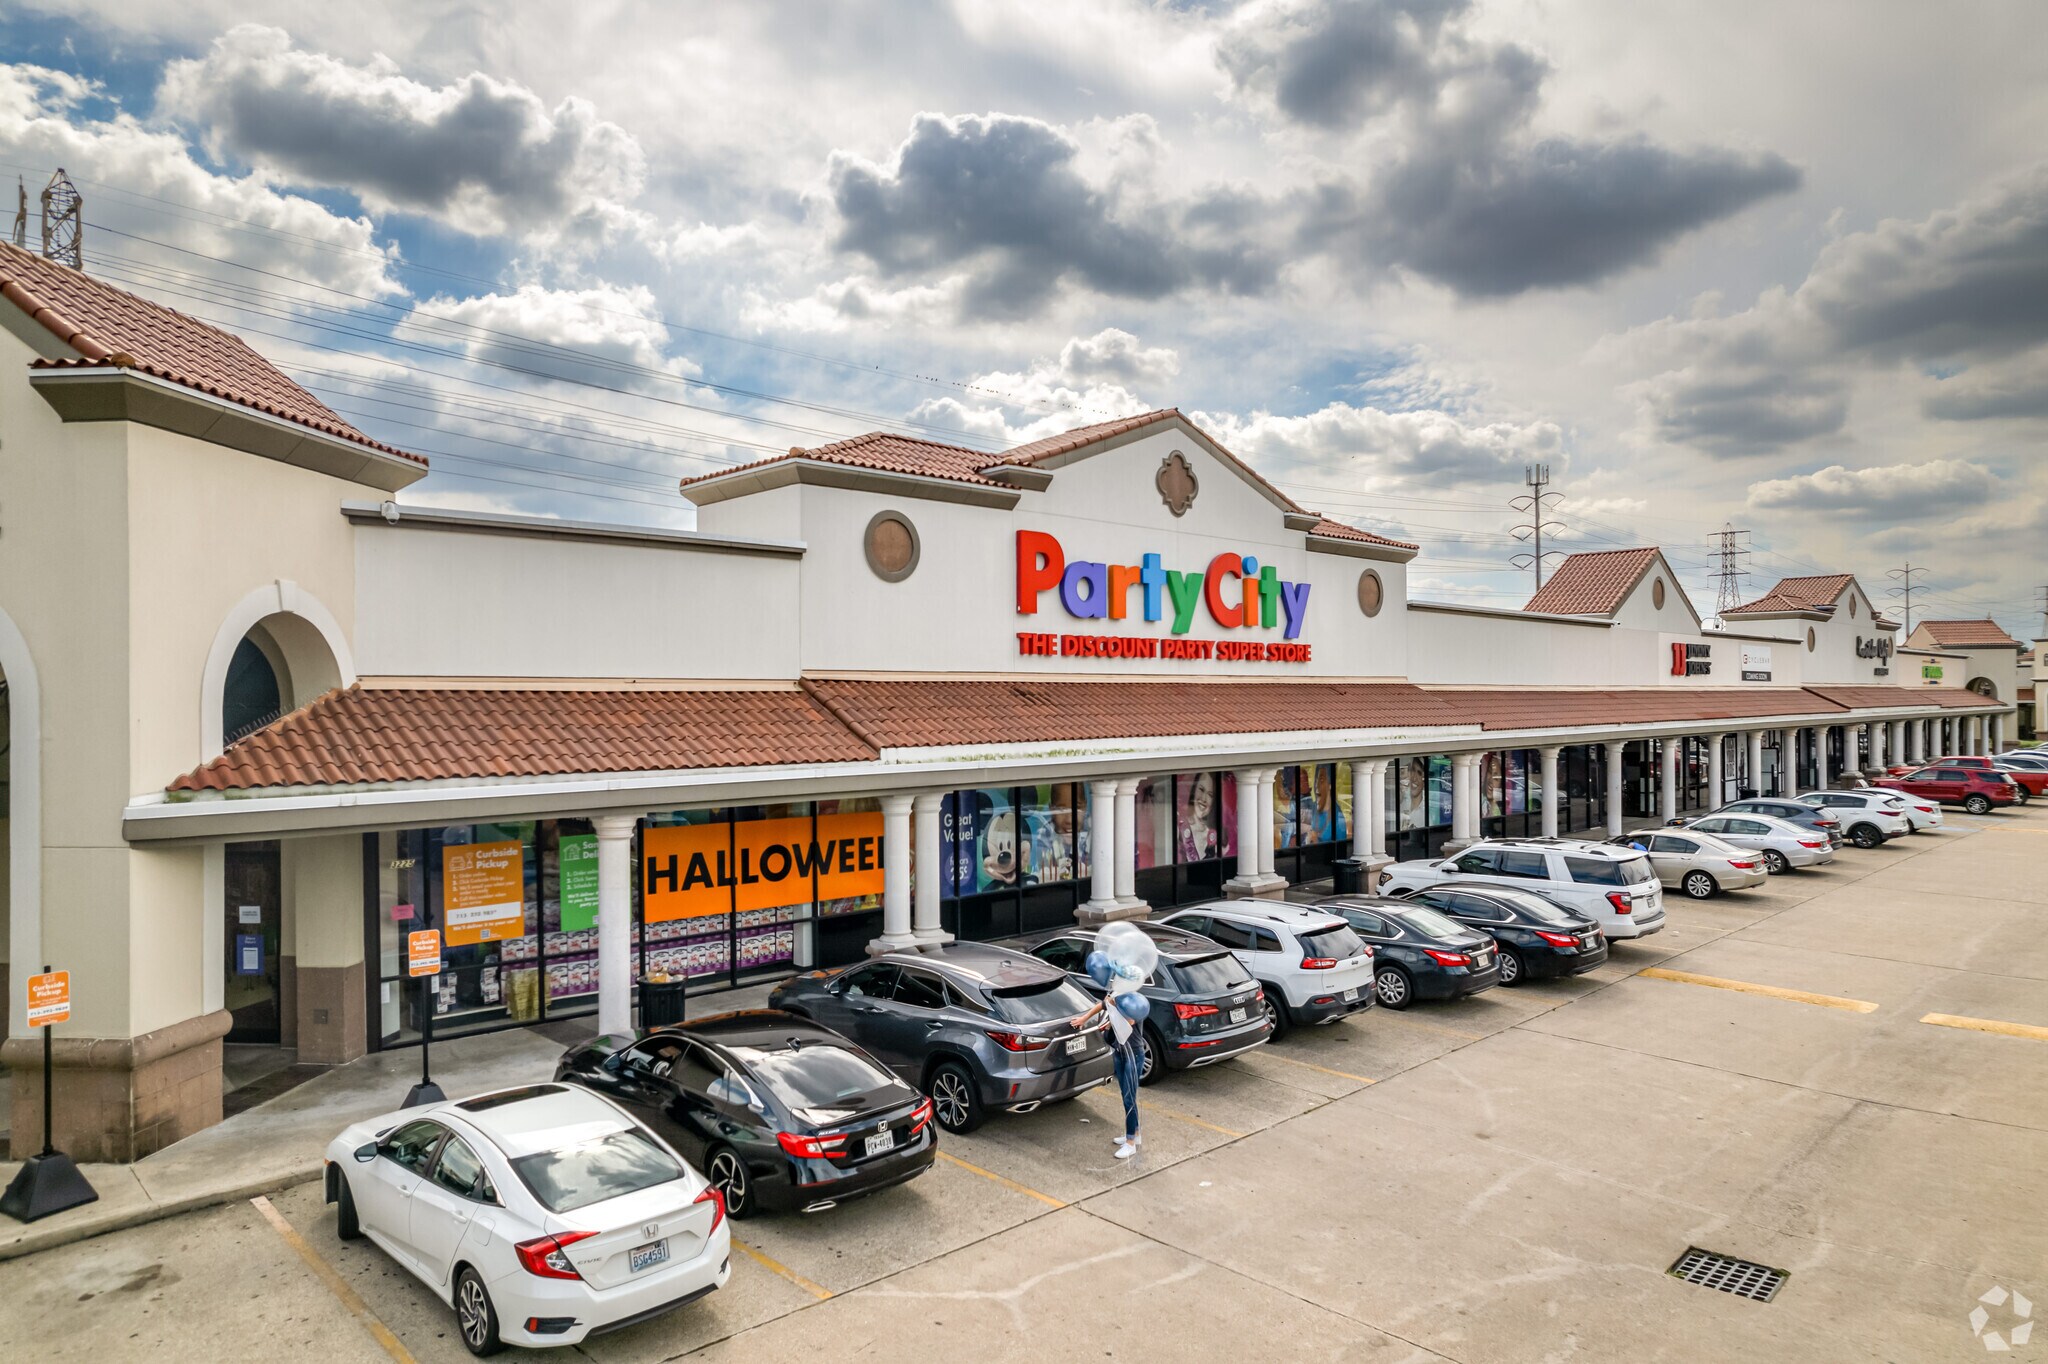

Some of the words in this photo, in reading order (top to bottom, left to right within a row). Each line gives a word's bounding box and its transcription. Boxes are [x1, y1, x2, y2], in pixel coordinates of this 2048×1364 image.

[1016, 632, 1058, 656] THE
[1061, 635, 1160, 659] DISCOUNT
[1161, 639, 1216, 661] PARTY
[1217, 641, 1267, 662] SUPER
[1267, 643, 1312, 662] STORE
[1686, 643, 1711, 659] JIMMY
[944, 813, 972, 827] Geat
[476, 847, 518, 859] Curbside
[476, 860, 508, 870] Pickup
[32, 981, 66, 992] Curbside
[36, 989, 62, 998] Pickup
[577, 1257, 602, 1265] CIVIC
